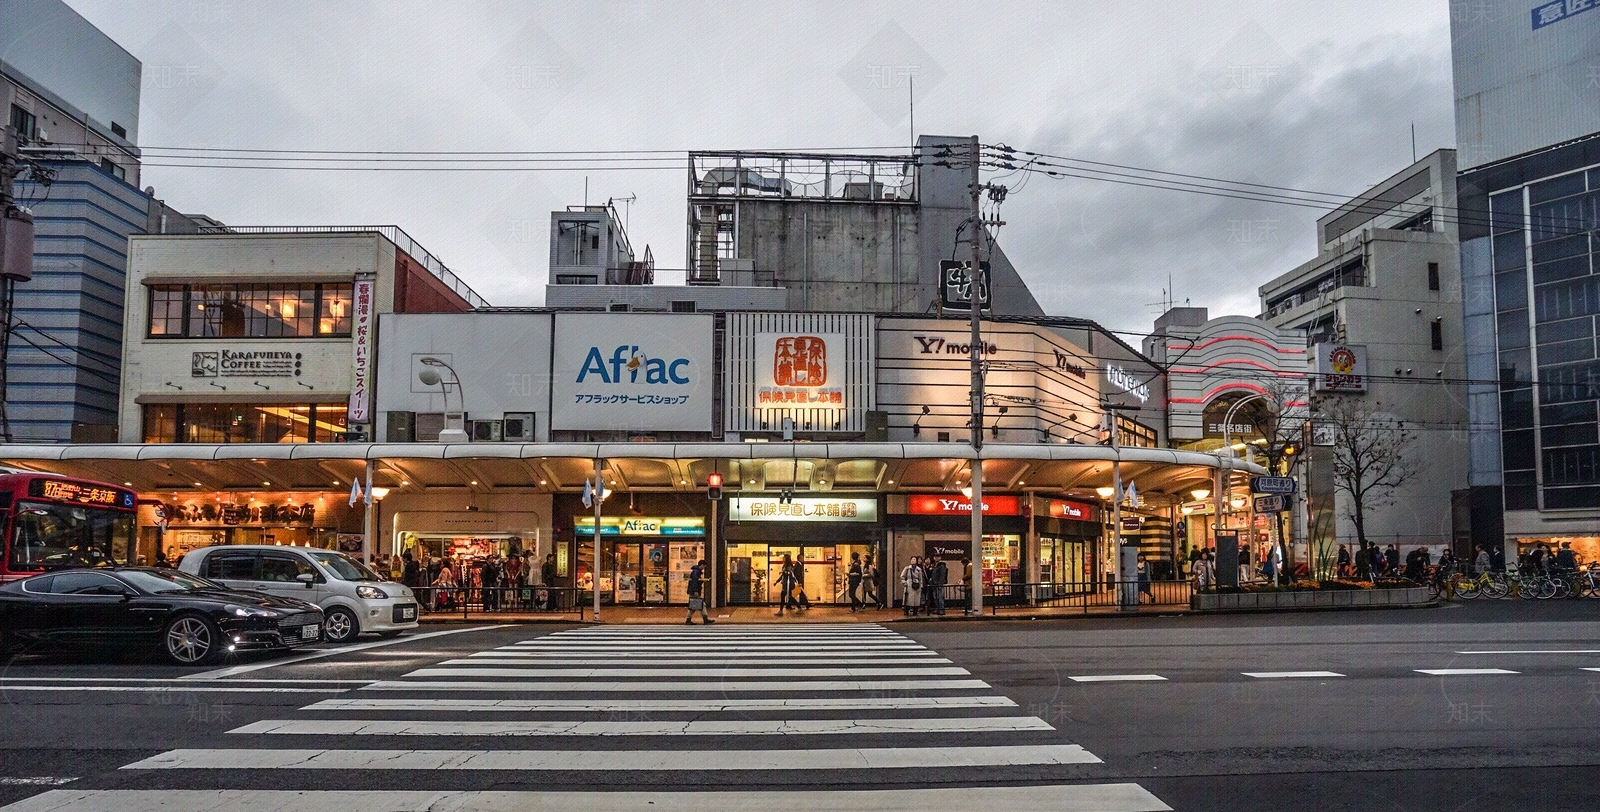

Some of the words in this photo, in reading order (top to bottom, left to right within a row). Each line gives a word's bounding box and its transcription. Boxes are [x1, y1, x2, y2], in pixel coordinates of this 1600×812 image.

[222, 350, 293, 360] KARAFUNEYA
[221, 359, 261, 369] COFFEE
[575, 395, 690, 405] アフラックサービスショップ
[759, 390, 842, 403] 保険見直し本舗
[83, 488, 117, 503] 三条京阪
[750, 502, 840, 517] 保険見直し本舗
